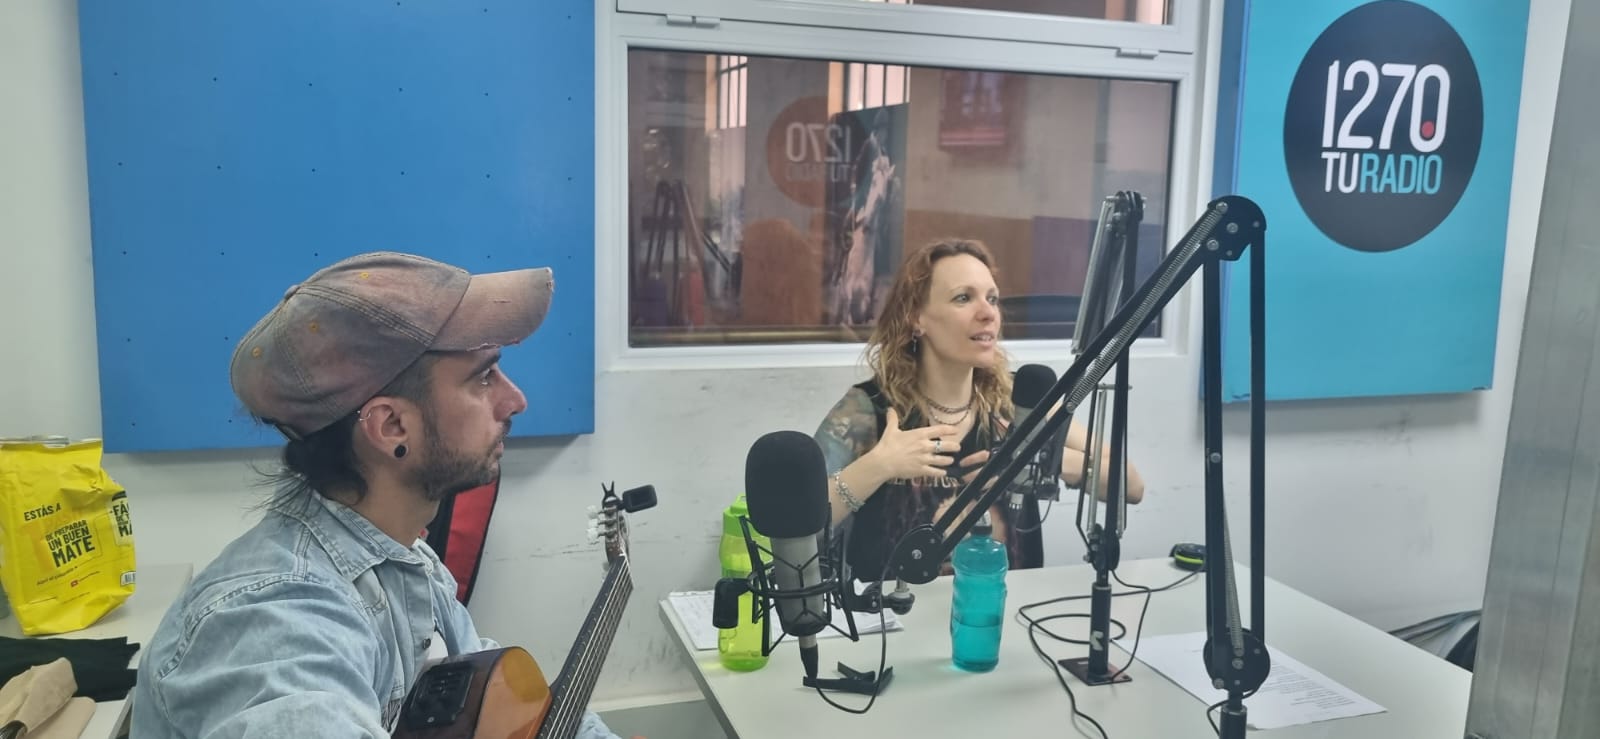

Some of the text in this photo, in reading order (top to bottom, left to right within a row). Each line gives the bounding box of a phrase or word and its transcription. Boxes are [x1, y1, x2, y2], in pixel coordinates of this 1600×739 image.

[1322, 60, 1450, 152] 1270
[24, 505, 54, 521] ESTÁS
[55, 502, 62, 512] A
[48, 526, 90, 551] UN BUEN
[52, 535, 95, 568] MATE
